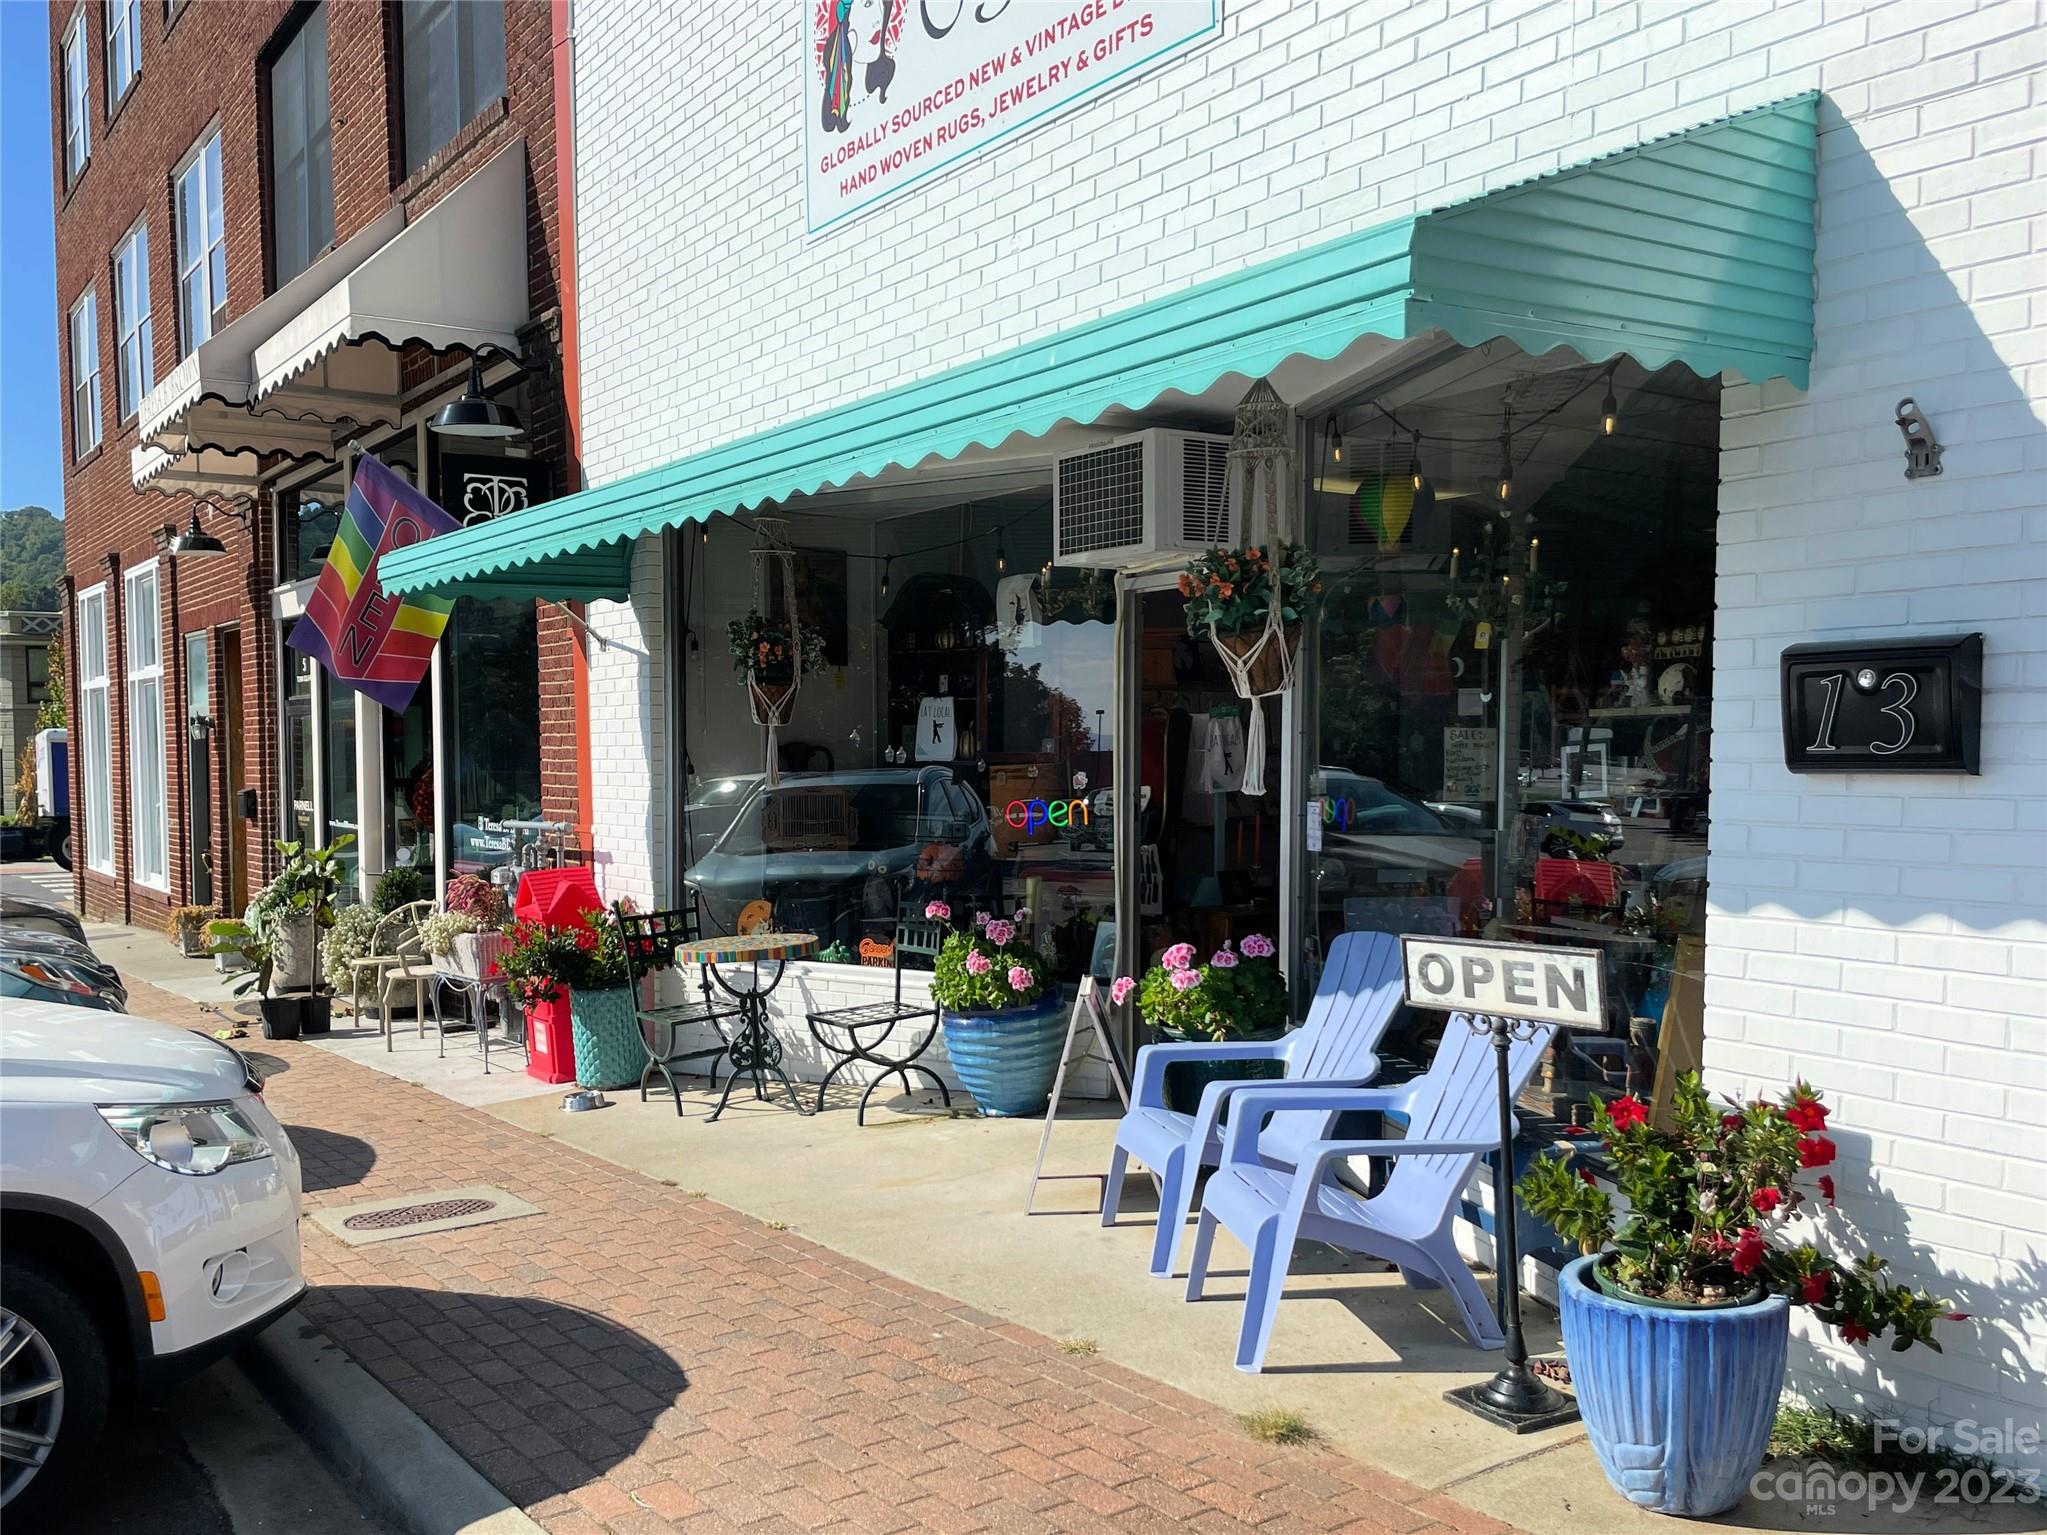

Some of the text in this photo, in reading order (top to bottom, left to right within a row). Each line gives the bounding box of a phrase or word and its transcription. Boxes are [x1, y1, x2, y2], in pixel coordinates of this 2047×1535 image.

[820, 120, 888, 173] GLOBALLY
[891, 78, 965, 133] SOURCED
[969, 53, 1006, 91] NEW
[1010, 47, 1022, 67] &
[1025, 0, 1107, 57] VINTAGE
[840, 13, 1153, 197] HAND WOVEN RUGS, JEWELRY & GIFTS
[339, 516, 432, 668] OEN
[1806, 672, 1917, 755] 13
[1005, 799, 1088, 836] open
[1417, 952, 1587, 1012] OPEN
